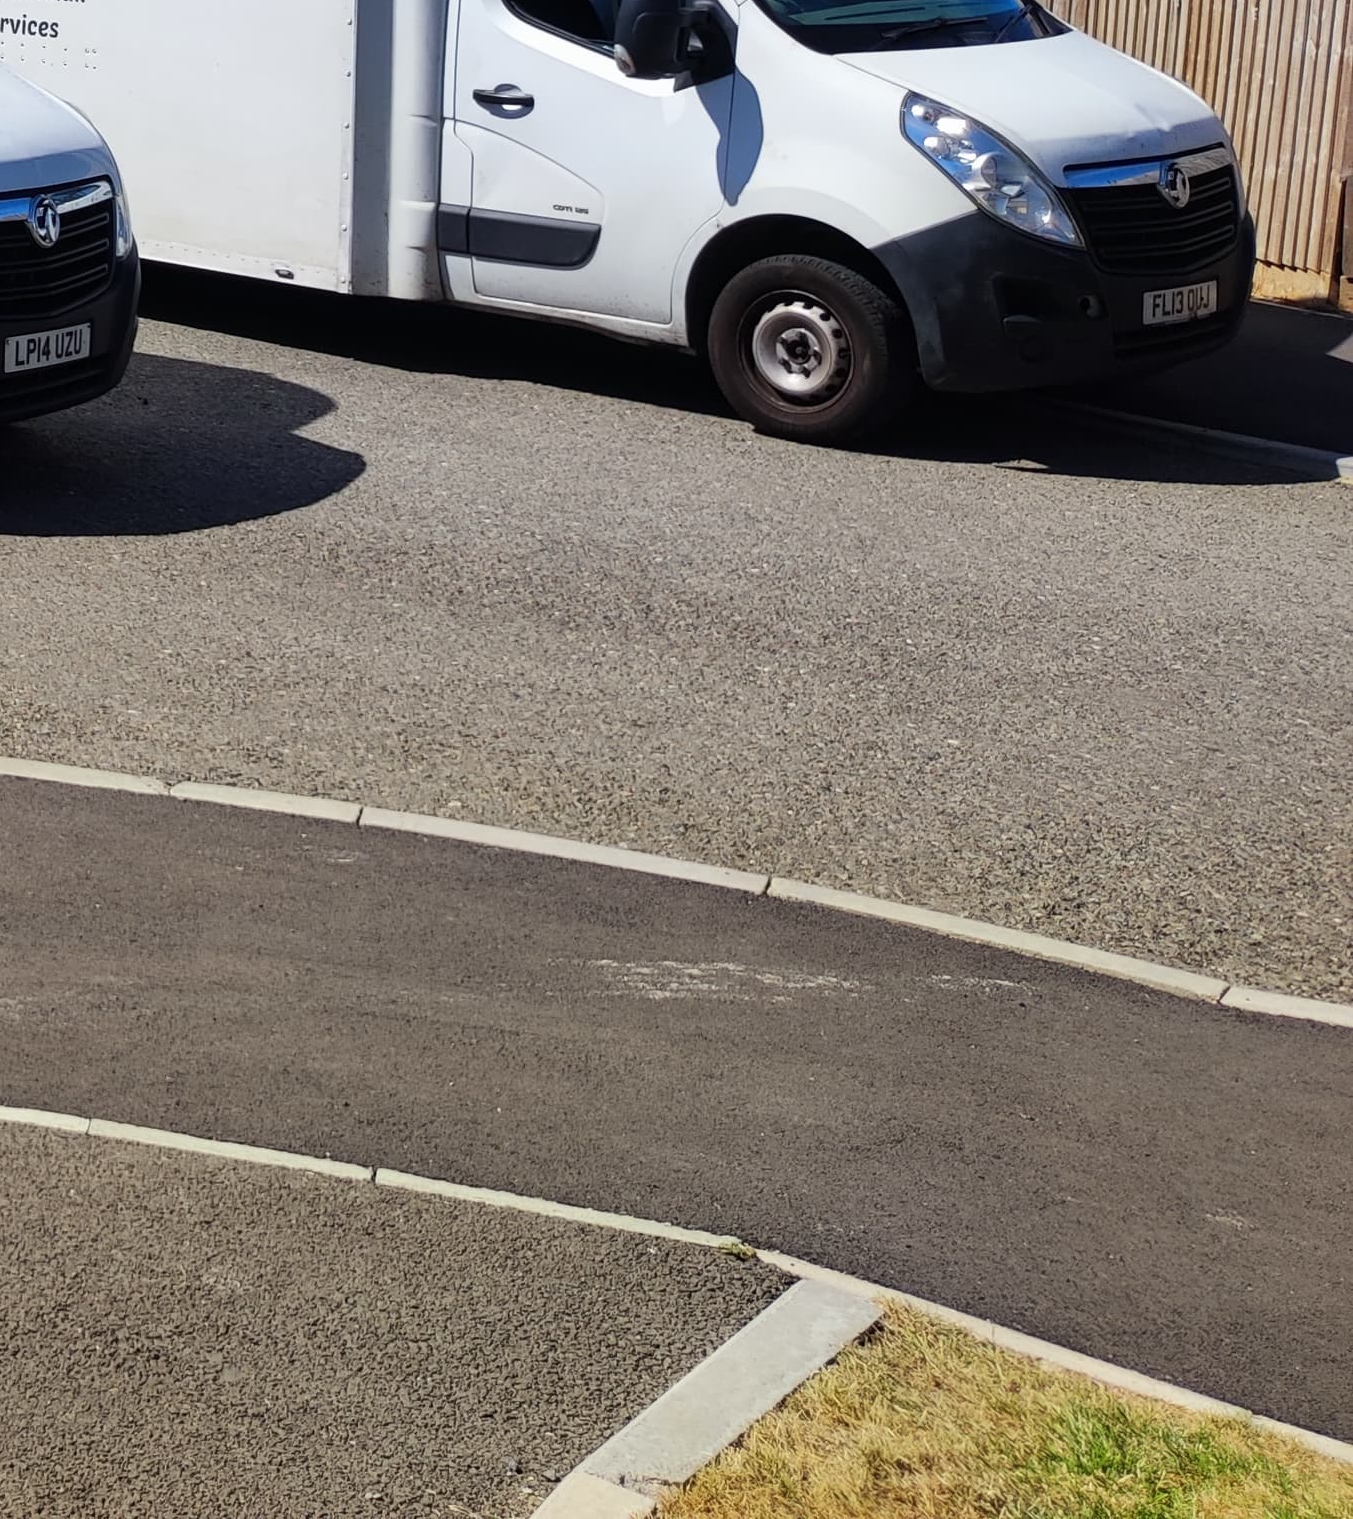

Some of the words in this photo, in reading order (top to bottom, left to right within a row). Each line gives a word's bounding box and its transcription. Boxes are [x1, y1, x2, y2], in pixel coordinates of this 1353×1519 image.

[1152, 290, 1184, 318] FL13
[15, 336, 51, 366] LP14
[55, 329, 82, 359] UZU
